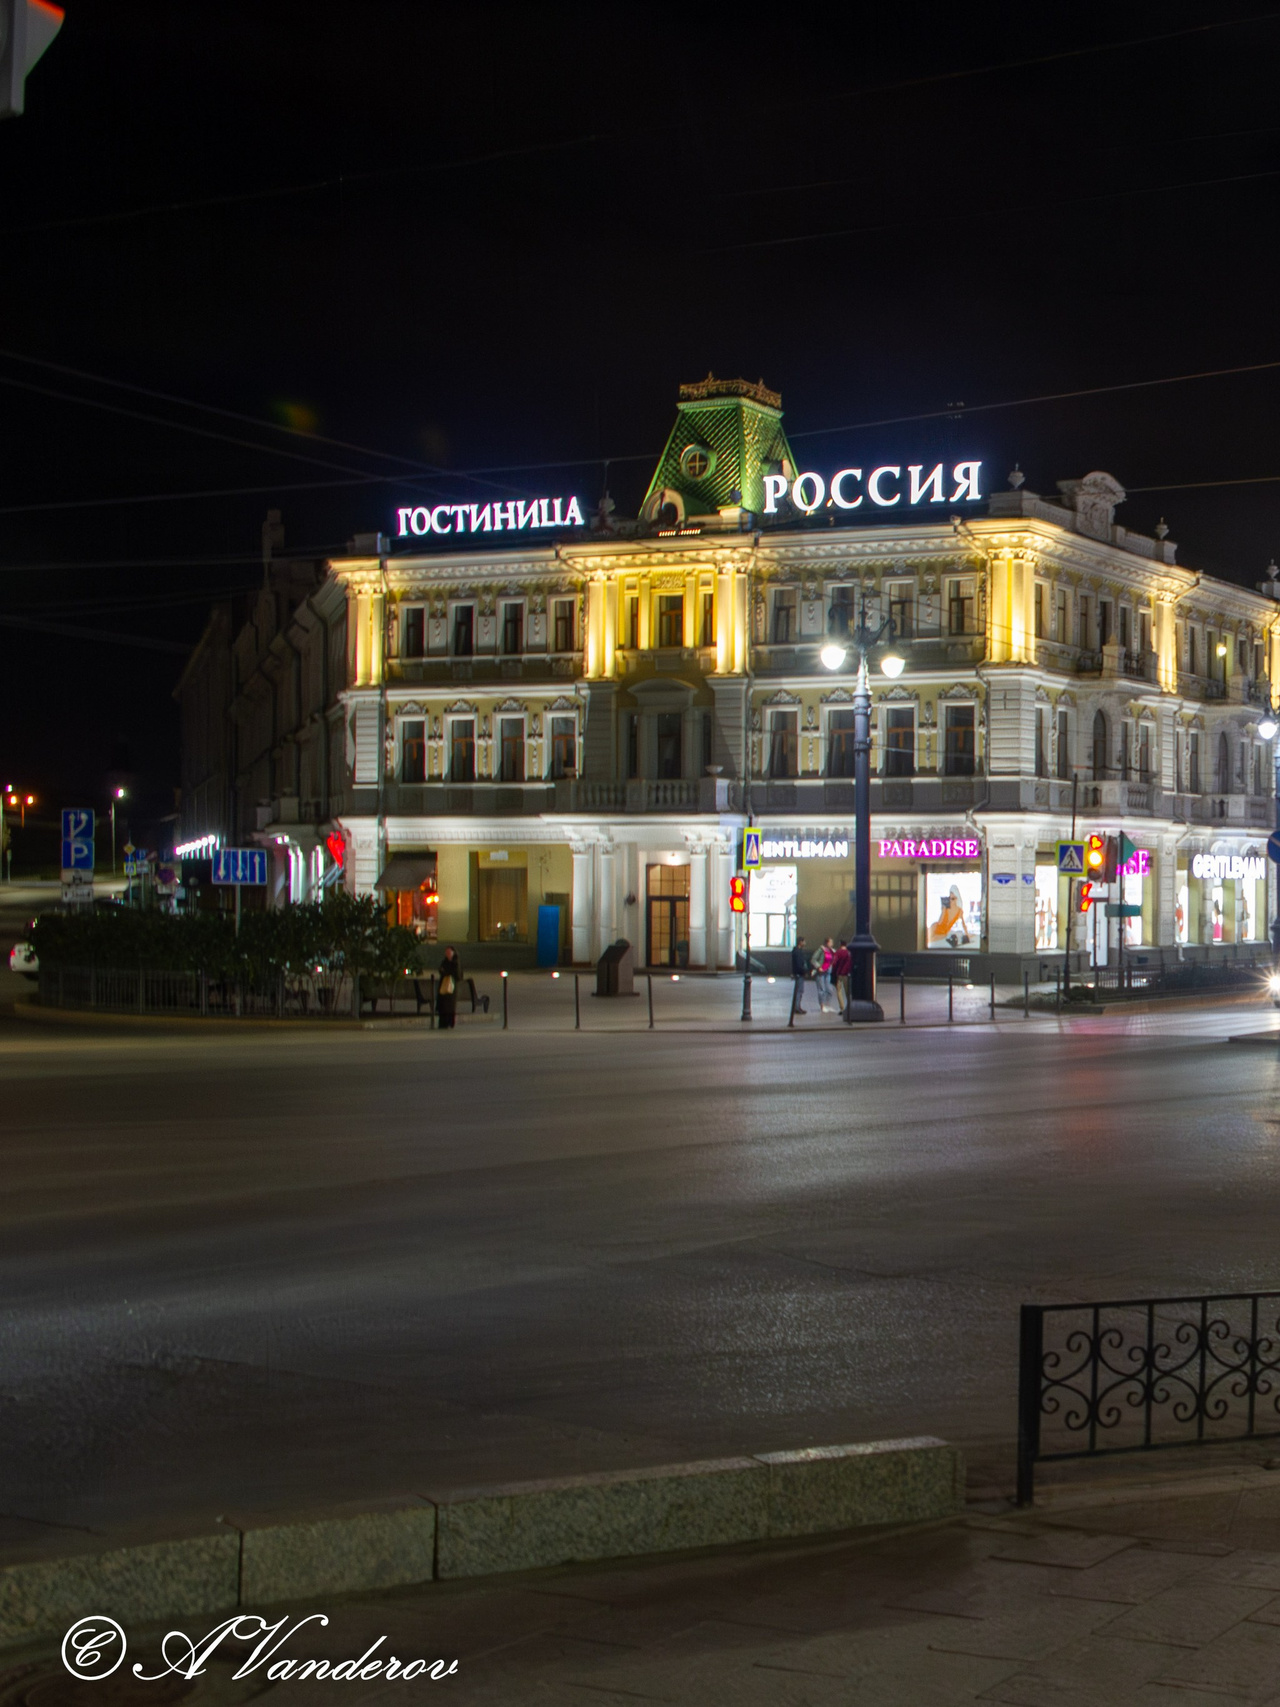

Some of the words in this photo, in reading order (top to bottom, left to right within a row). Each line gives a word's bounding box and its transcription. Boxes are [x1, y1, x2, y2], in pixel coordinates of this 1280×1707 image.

[763, 461, 983, 514] РОССИЯ
[396, 496, 585, 537] ГОСТИНИЦА
[760, 840, 848, 858] ENTLEMAN
[879, 839, 979, 858] PARADISE
[1192, 853, 1267, 880] GENTLEMAN
